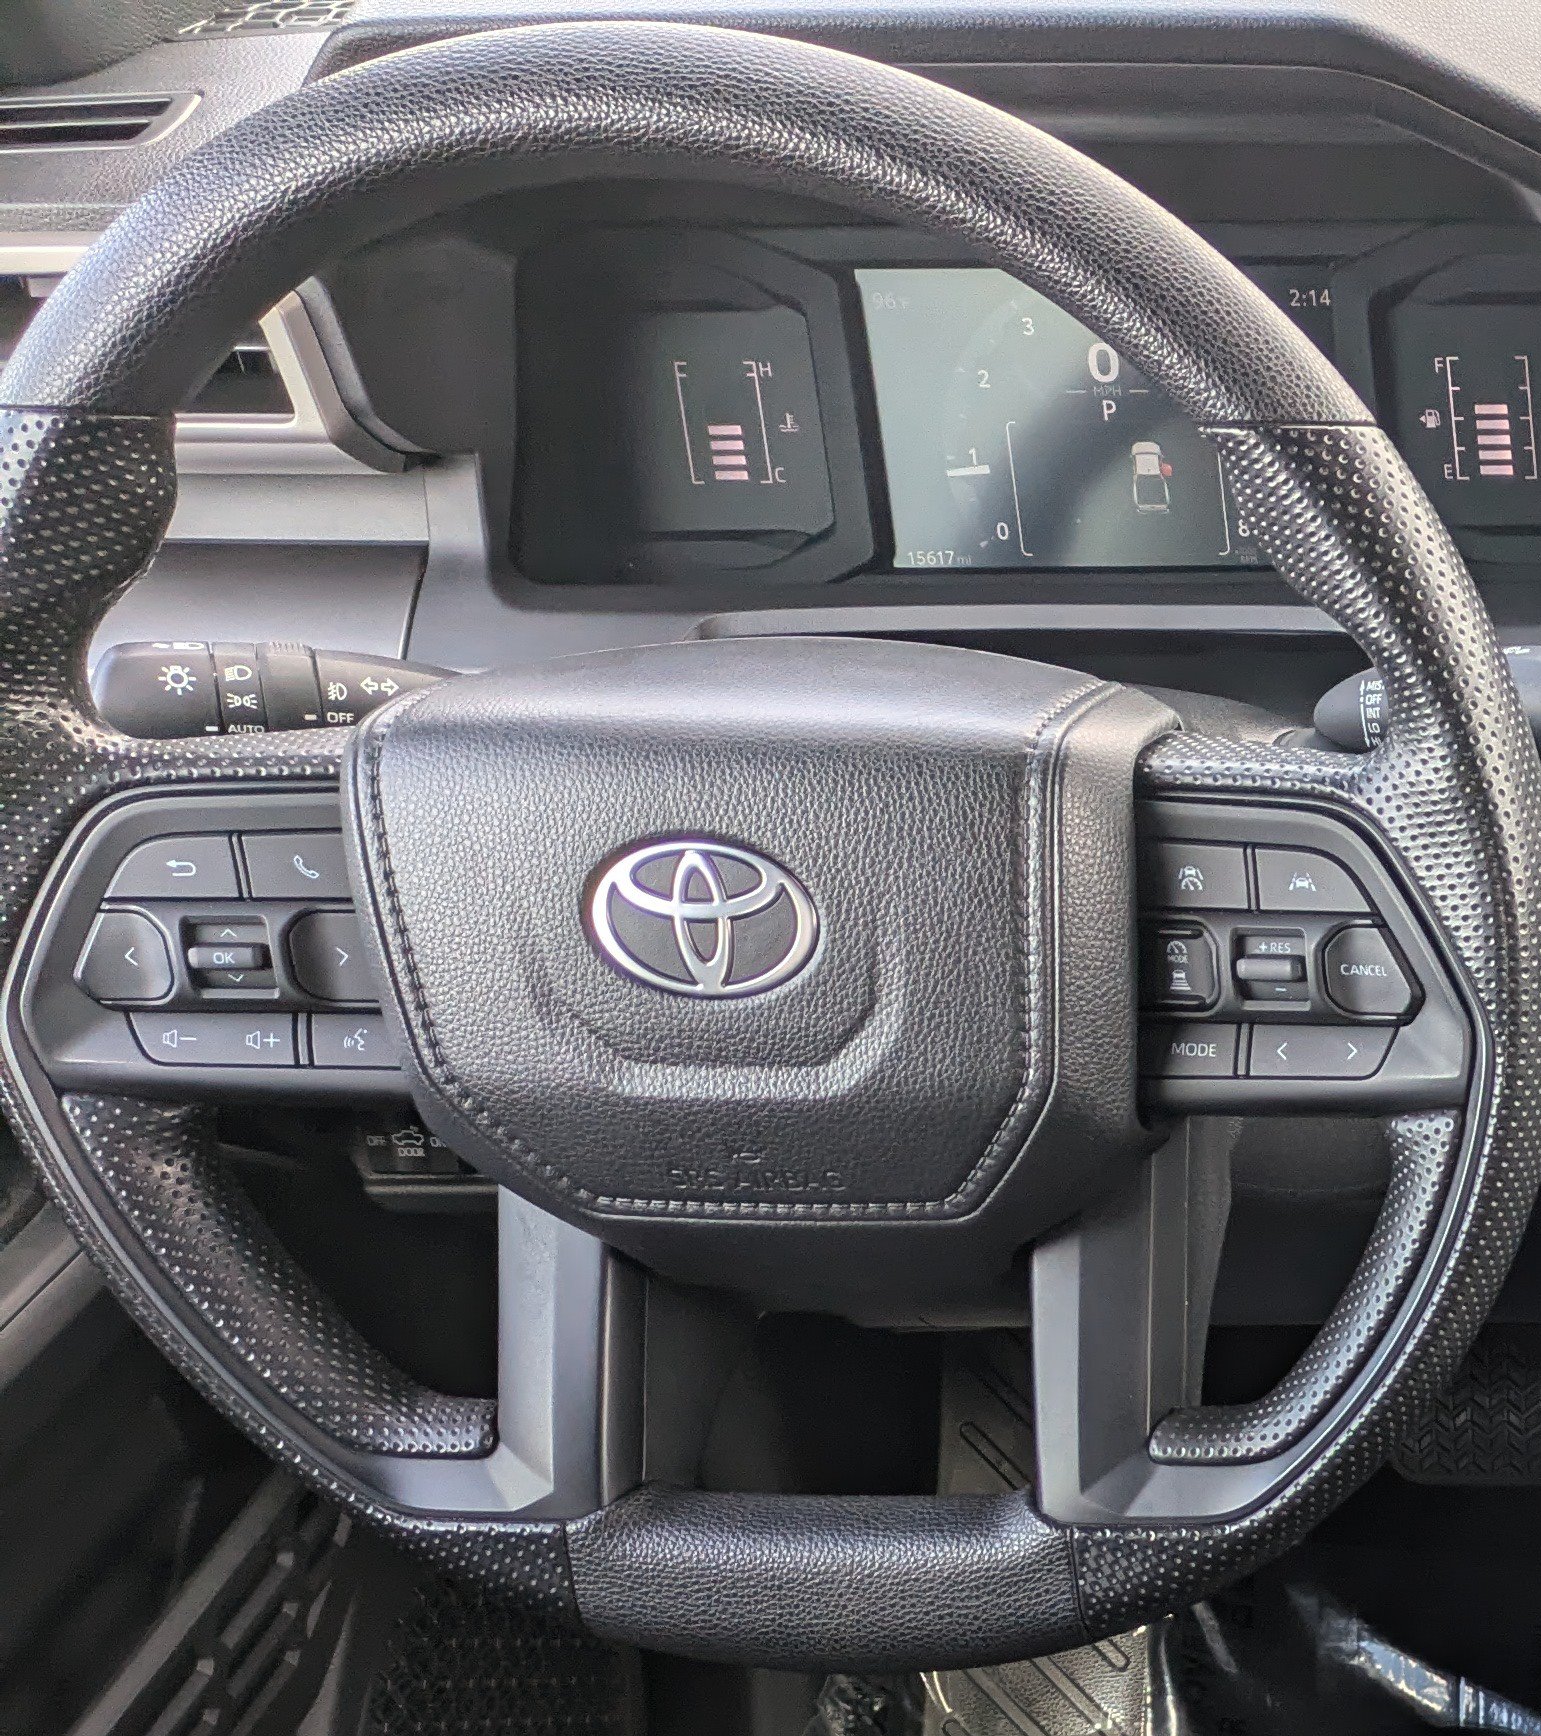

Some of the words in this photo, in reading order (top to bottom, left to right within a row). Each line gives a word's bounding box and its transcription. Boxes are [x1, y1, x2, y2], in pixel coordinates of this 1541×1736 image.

[1289, 289, 1331, 307] 2:14
[1021, 317, 1035, 336] 3
[758, 362, 772, 378] H
[1088, 342, 1120, 383] 0
[1434, 357, 1444, 373] F
[977, 369, 991, 388] 2
[1102, 399, 1117, 421] P
[968, 447, 978, 467] 1
[774, 467, 786, 483] C
[1444, 464, 1454, 480] E
[996, 522, 1009, 541] 0
[907, 550, 955, 566] 15617
[1365, 693, 1382, 706] OFF
[327, 712, 354, 724] OFF
[227, 724, 266, 734] AUTO
[1367, 722, 1381, 734] LO
[213, 952, 236, 964] OK
[1167, 954, 1189, 964] MODE
[1340, 963, 1388, 977] CANCEL
[1171, 1043, 1217, 1057] MODE
